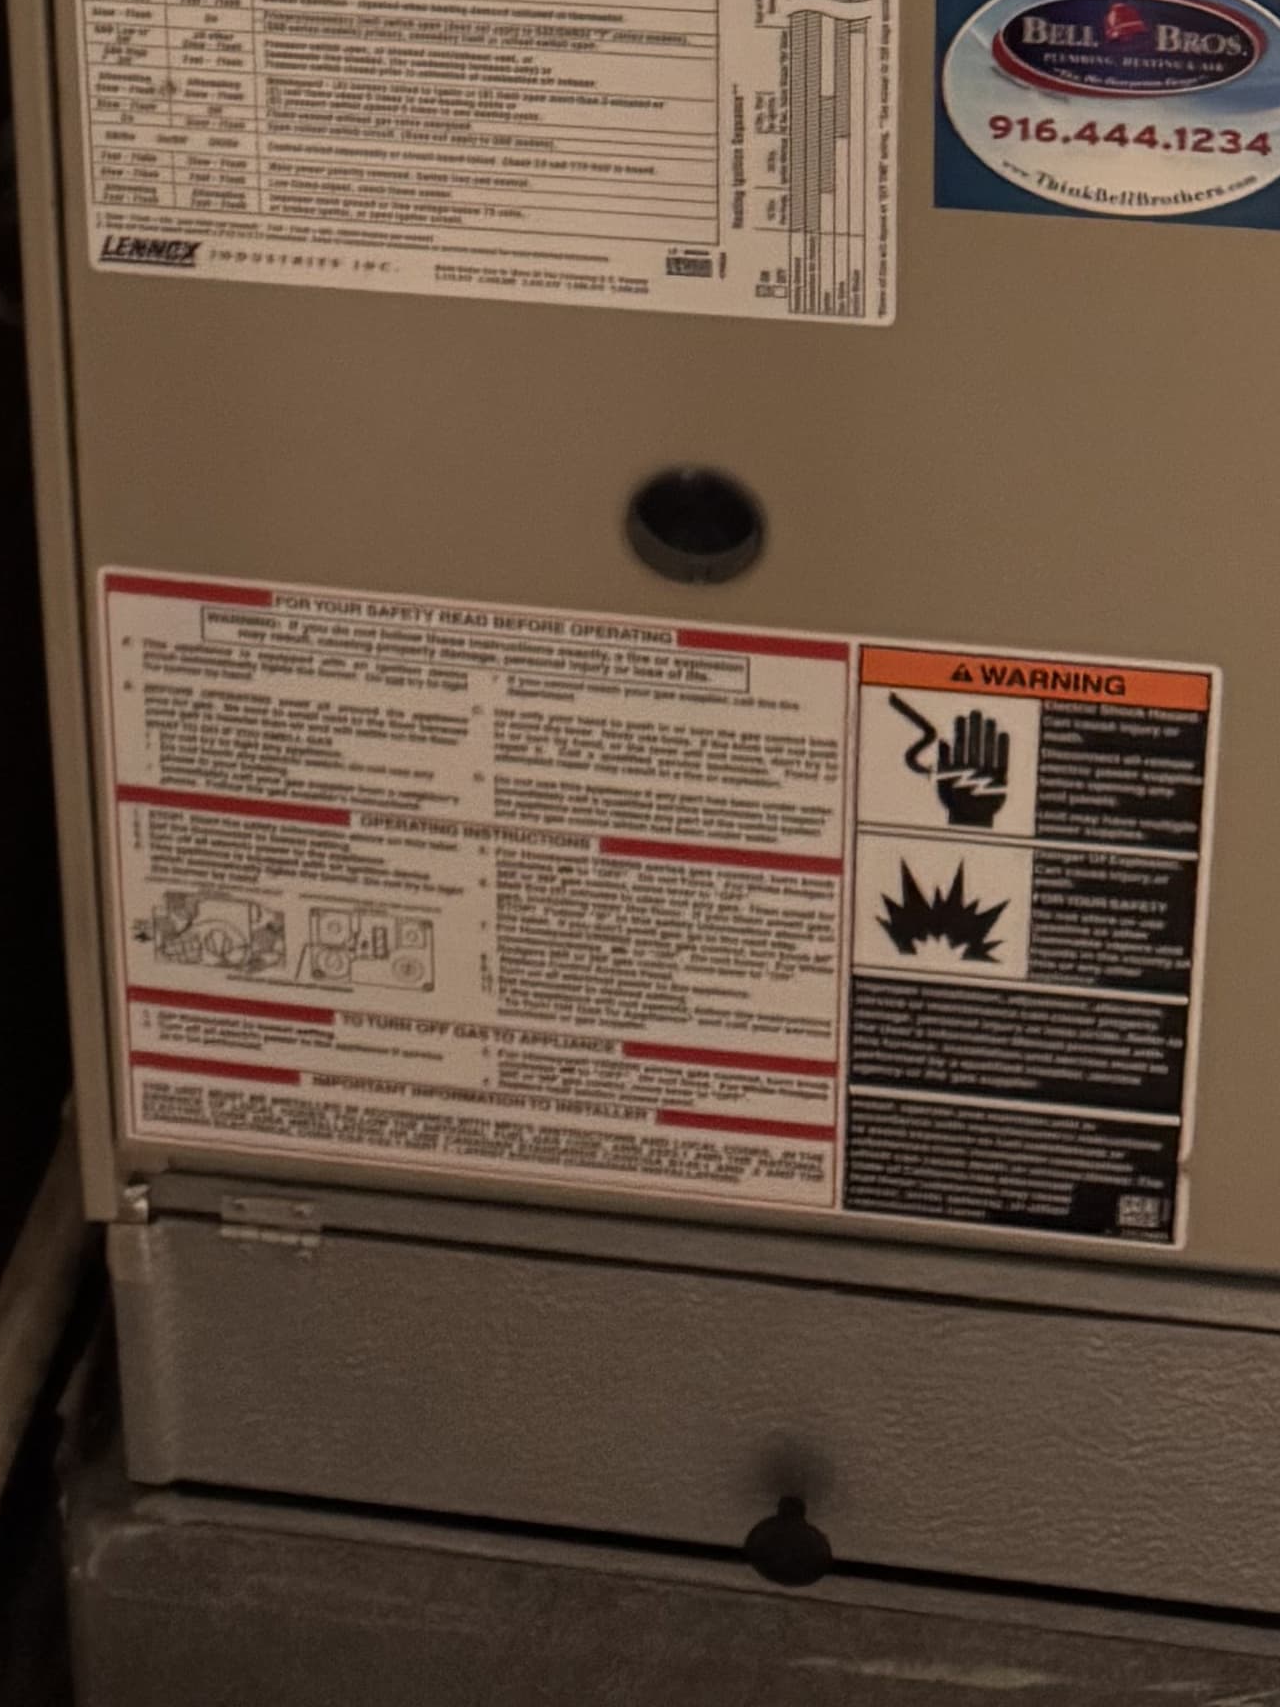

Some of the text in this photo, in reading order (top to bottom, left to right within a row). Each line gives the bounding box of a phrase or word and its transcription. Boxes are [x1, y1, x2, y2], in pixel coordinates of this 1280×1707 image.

[1021, 15, 1249, 58] BELL BROS.
[988, 114, 1273, 157] 916.444.1234
[100, 234, 202, 262] LENNOX
[275, 595, 673, 645] FOR YOUR SAFETY READ BEFORE OPERATING
[979, 663, 1127, 696] WARNING
